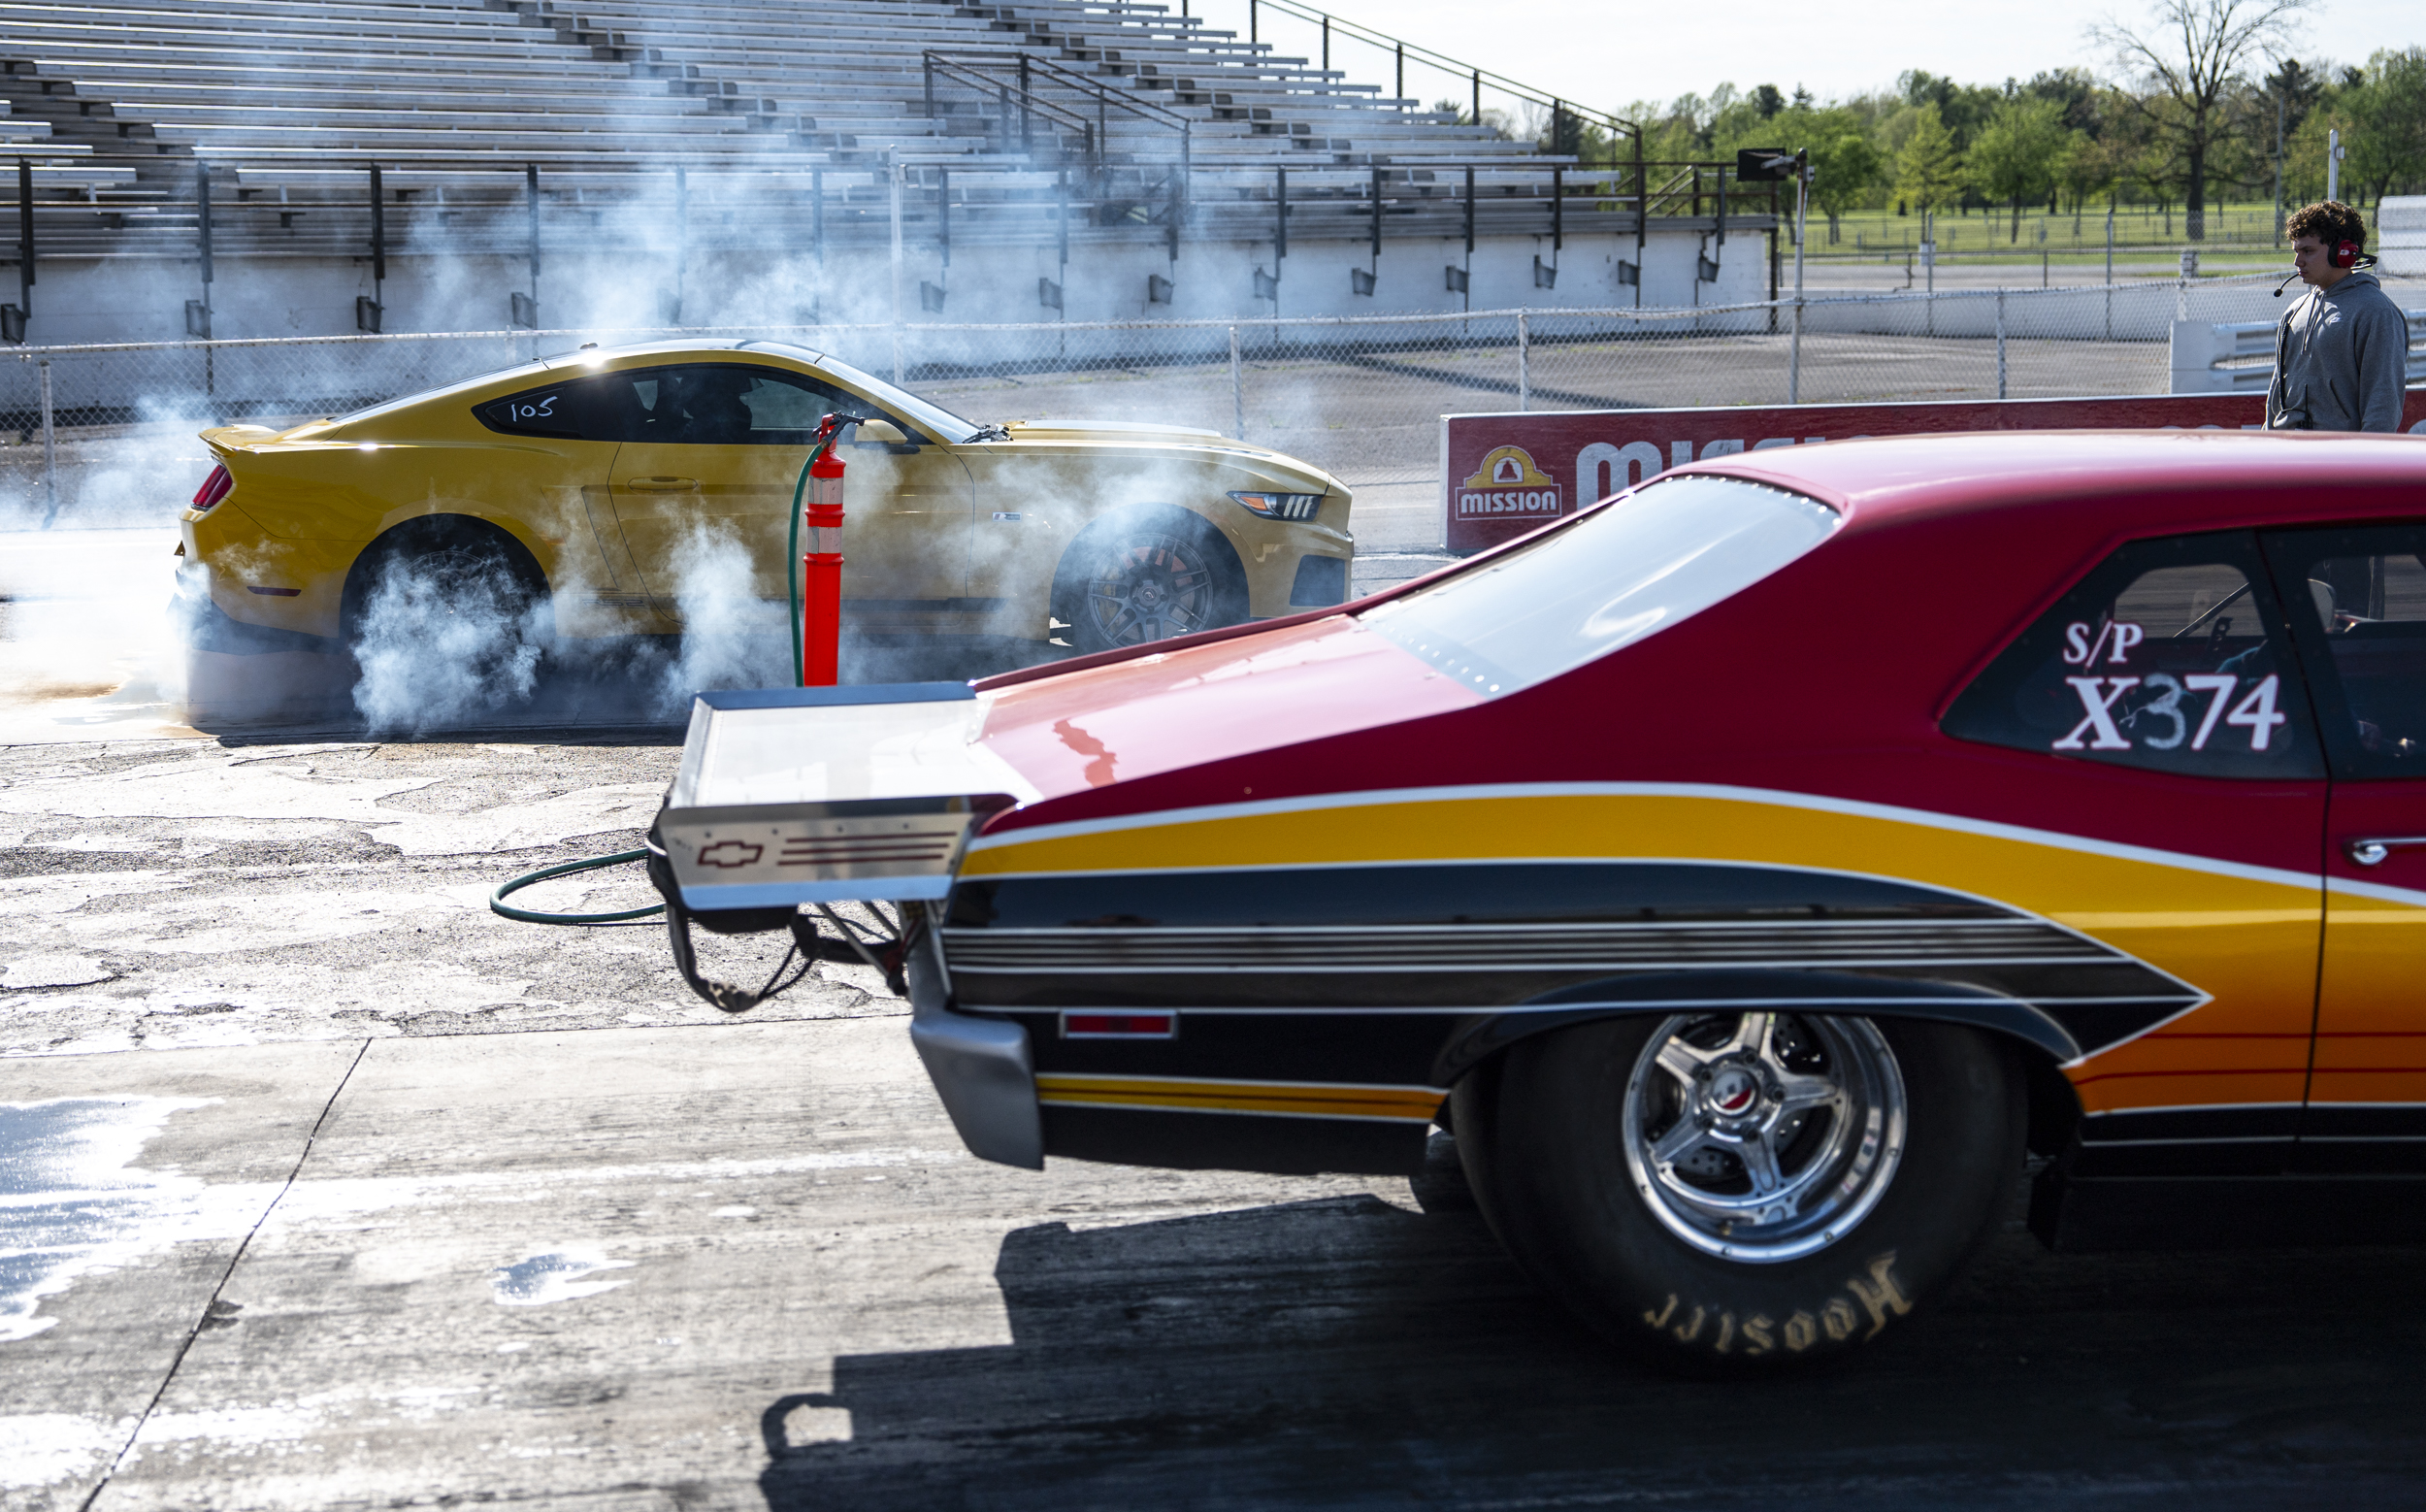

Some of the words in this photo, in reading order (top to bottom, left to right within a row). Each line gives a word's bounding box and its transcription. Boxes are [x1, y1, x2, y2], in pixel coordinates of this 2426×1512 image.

[510, 395, 558, 422] 105
[1460, 491, 1557, 514] MISSION
[2063, 620, 2144, 669] S/P
[2051, 674, 2286, 751] X374
